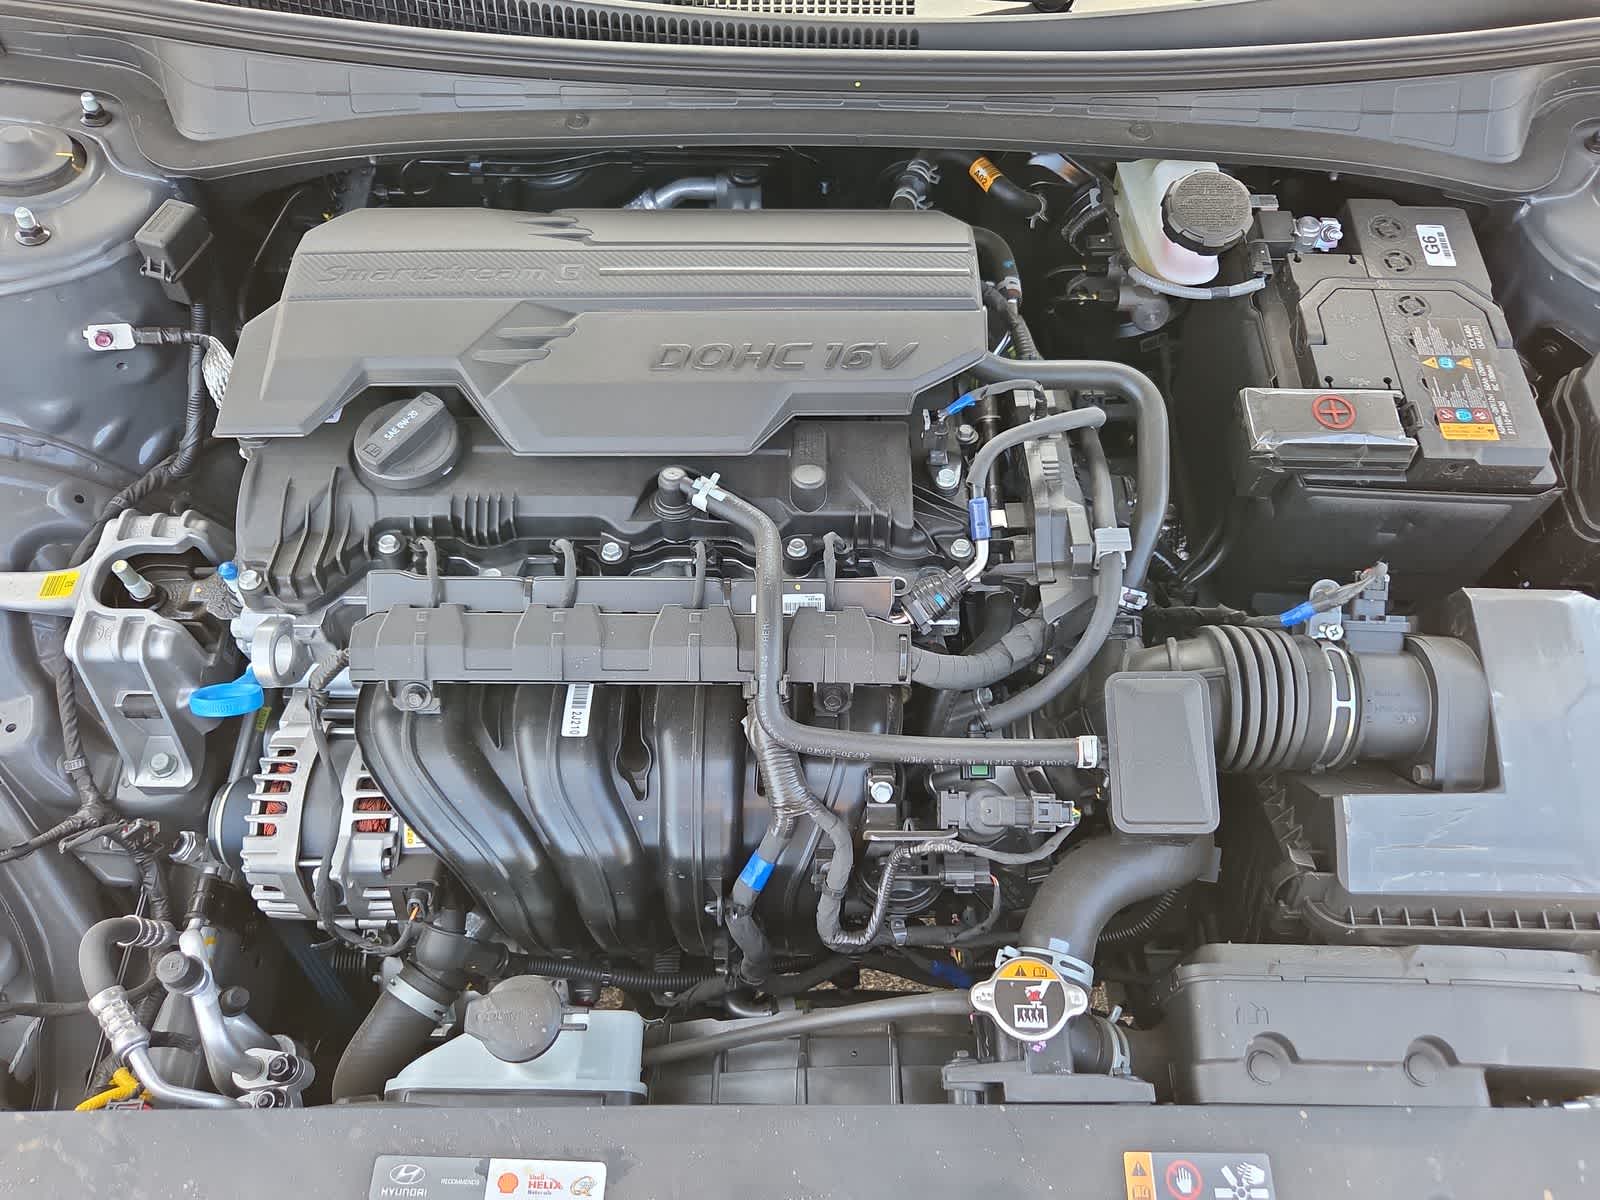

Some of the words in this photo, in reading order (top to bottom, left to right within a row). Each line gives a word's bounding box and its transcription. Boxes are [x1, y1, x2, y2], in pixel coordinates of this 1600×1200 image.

[1422, 236, 1440, 254] G6
[318, 264, 546, 283] Smartstream
[649, 342, 814, 371] DOHC
[823, 341, 920, 370] 16V
[384, 426, 400, 440] SAE
[381, 1187, 428, 1197] HYUNDAI
[528, 1179, 563, 1190] HELIX
